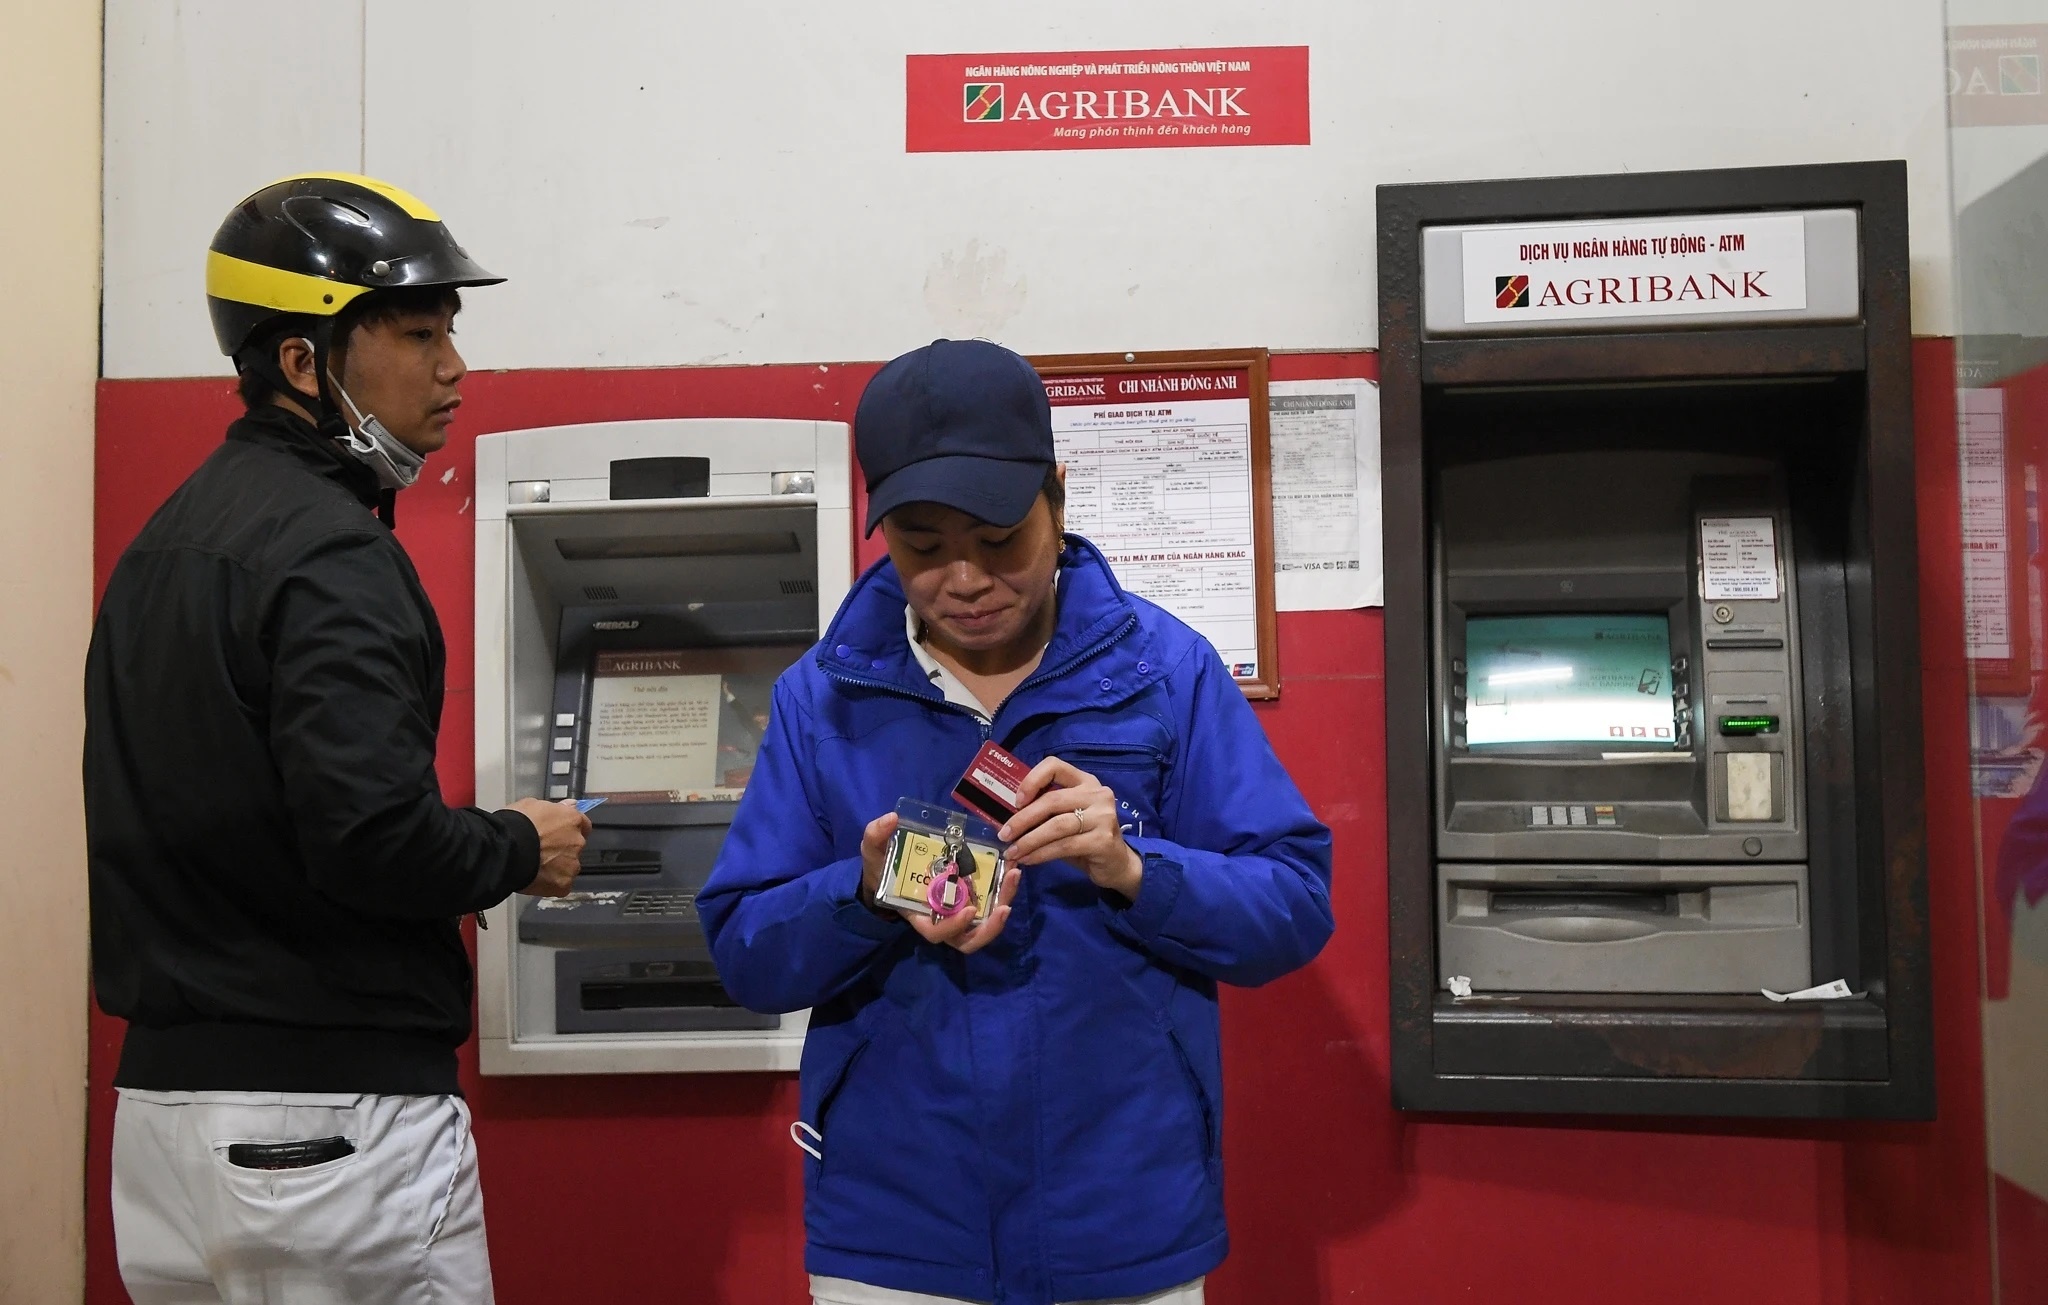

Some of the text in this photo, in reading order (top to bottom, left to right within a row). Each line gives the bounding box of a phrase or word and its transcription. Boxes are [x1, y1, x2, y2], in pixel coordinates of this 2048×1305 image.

[966, 60, 1250, 77] NGÂN HÀNG NÔNG NGHIỆP VÀ PHÁT TRIỂN NÔNG THÔN VIỆT NAM
[1009, 87, 1250, 120] AGRIBANK
[1054, 128, 1086, 139] Mang
[1123, 126, 1154, 137] thịnh
[1158, 124, 1178, 135] đến
[1182, 124, 1217, 134] khách
[1221, 124, 1251, 135] hàng
[1520, 243, 1549, 264] DỊCH
[1553, 242, 1568, 263] VỤ
[1573, 237, 1608, 258] NGÂN
[1613, 236, 1647, 257] HÀNG
[1651, 236, 1668, 258] TỰ
[1671, 233, 1706, 258] ĐỘNG
[1719, 234, 1744, 252] ATM
[1536, 271, 1772, 307] AGRIBANK
[1046, 384, 1106, 397] GRIBANK
[1119, 380, 1138, 394] CHI
[1140, 376, 1178, 393] NHÁNH
[1180, 374, 1211, 391] ĐÔNG
[1214, 376, 1237, 389] ANH
[1126, 410, 1142, 419] DỊCH
[1145, 410, 1156, 418] TẠI
[1133, 553, 1148, 561] MÁY
[1167, 552, 1180, 560] CỦA
[613, 660, 680, 671] AGRIBANK
